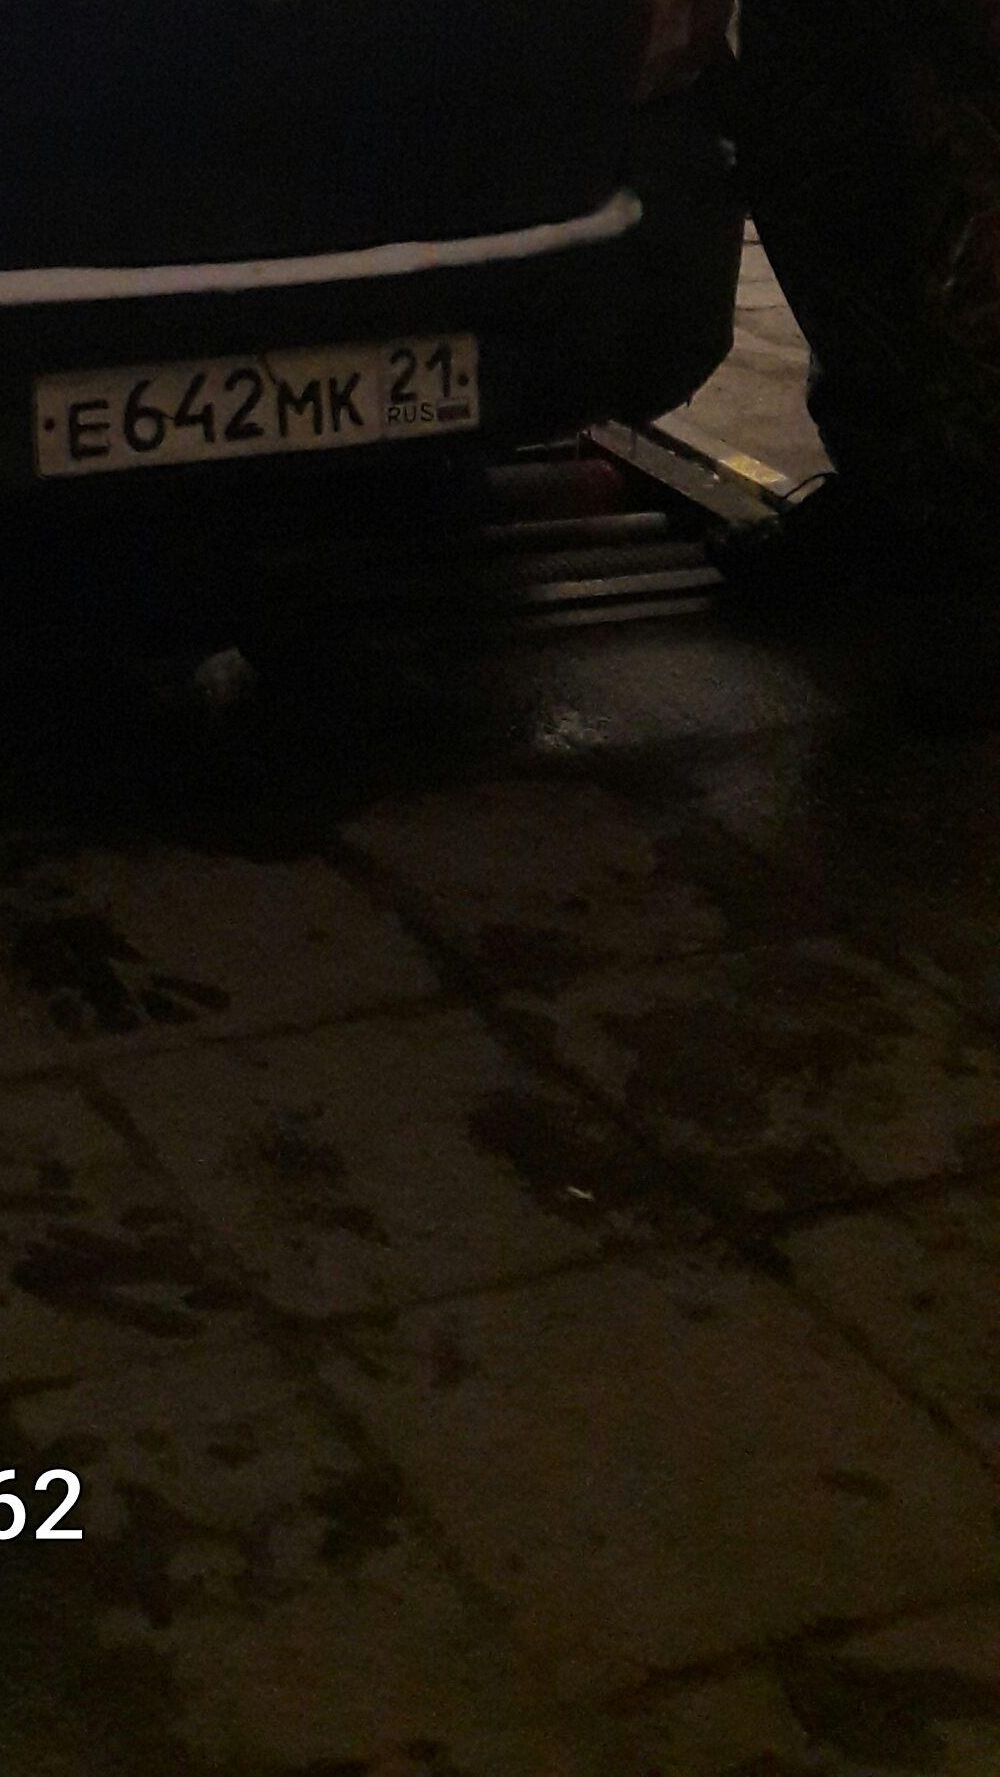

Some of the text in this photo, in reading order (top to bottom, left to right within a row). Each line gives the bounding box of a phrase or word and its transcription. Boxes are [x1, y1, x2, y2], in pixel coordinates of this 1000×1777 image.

[67, 341, 453, 461] Е642МК 21
[386, 403, 436, 425] RUS
